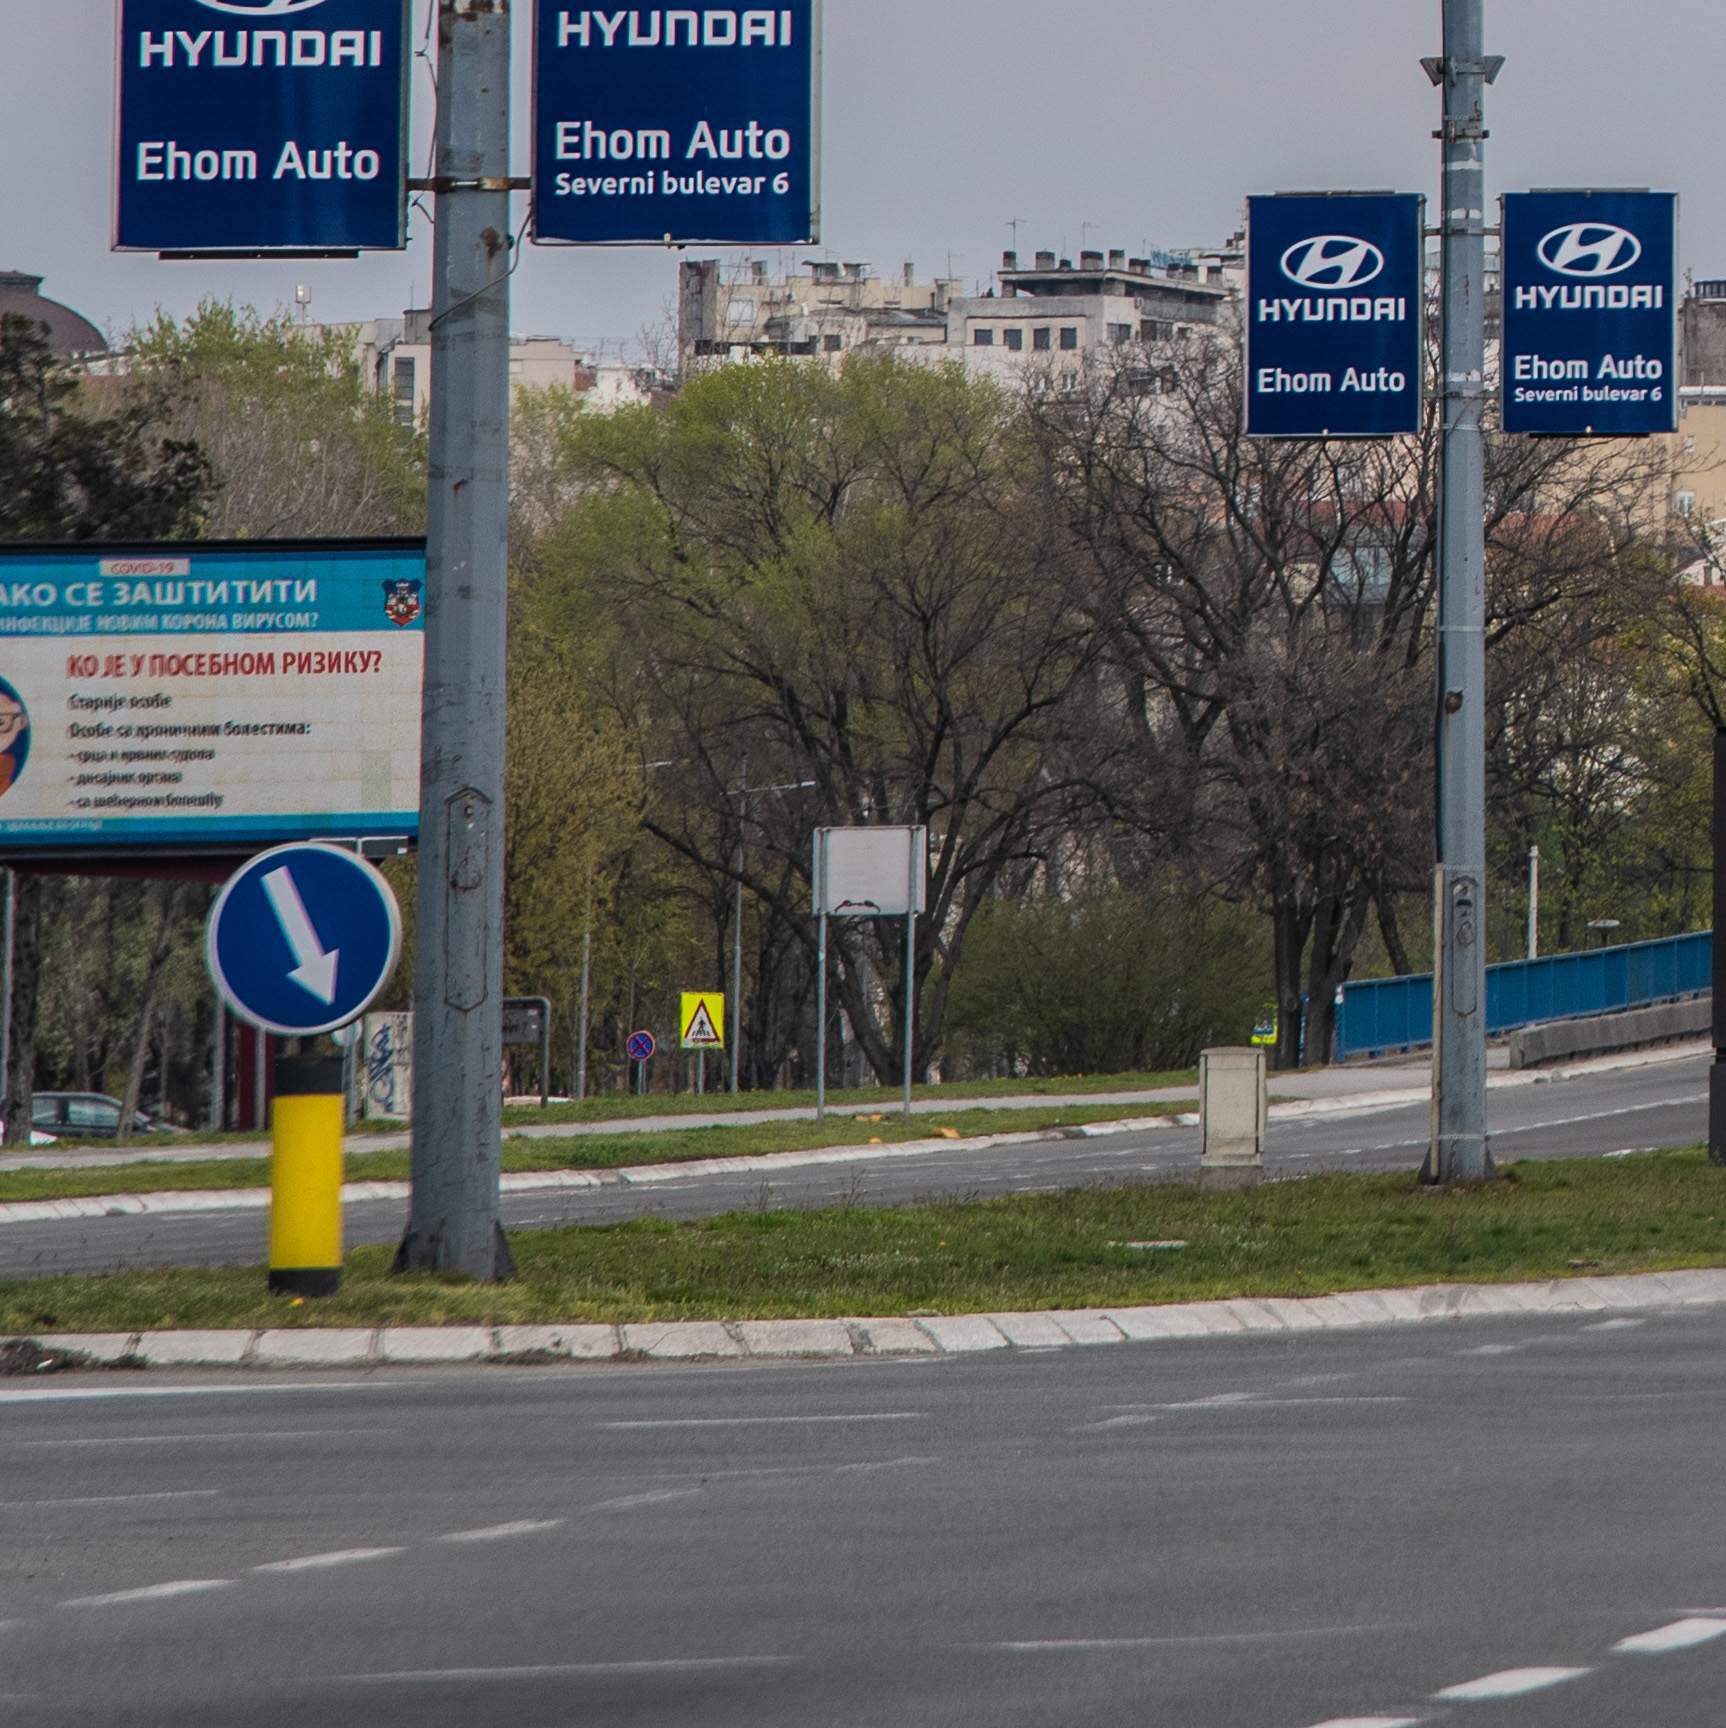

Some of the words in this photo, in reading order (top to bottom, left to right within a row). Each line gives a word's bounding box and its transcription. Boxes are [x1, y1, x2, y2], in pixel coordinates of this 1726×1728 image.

[557, 10, 793, 47] HYUNDAI
[140, 30, 381, 67] HYUNDAI
[555, 120, 670, 160] Ehom
[686, 120, 791, 160] Auto
[137, 142, 257, 181] Ehom
[273, 141, 380, 181] Auto
[554, 171, 654, 195] Severni
[662, 171, 765, 195] bulevar
[772, 172, 790, 195] 6
[1258, 298, 1405, 322] HYUNDAI
[1515, 285, 1662, 309] HYUNDAI
[1257, 368, 1332, 393] Ehom
[1339, 367, 1406, 393] Auto
[1514, 355, 1589, 380] Ehom
[1596, 354, 1663, 379] Auto
[1514, 386, 1578, 402] Severni
[1582, 386, 1647, 402] bulevar
[1651, 387, 1662, 402] 6
[65, 582, 104, 607] СЕ
[112, 579, 318, 606] ЗАШТИТИТИ
[160, 612, 228, 630] КОРОНА
[232, 612, 319, 629] ВИРУСОМ?
[130, 654, 146, 678] У
[149, 652, 275, 677] ПОСЕБНОМ
[282, 650, 382, 675] РИЗИКУ?
[223, 721, 312, 737] болестима:
